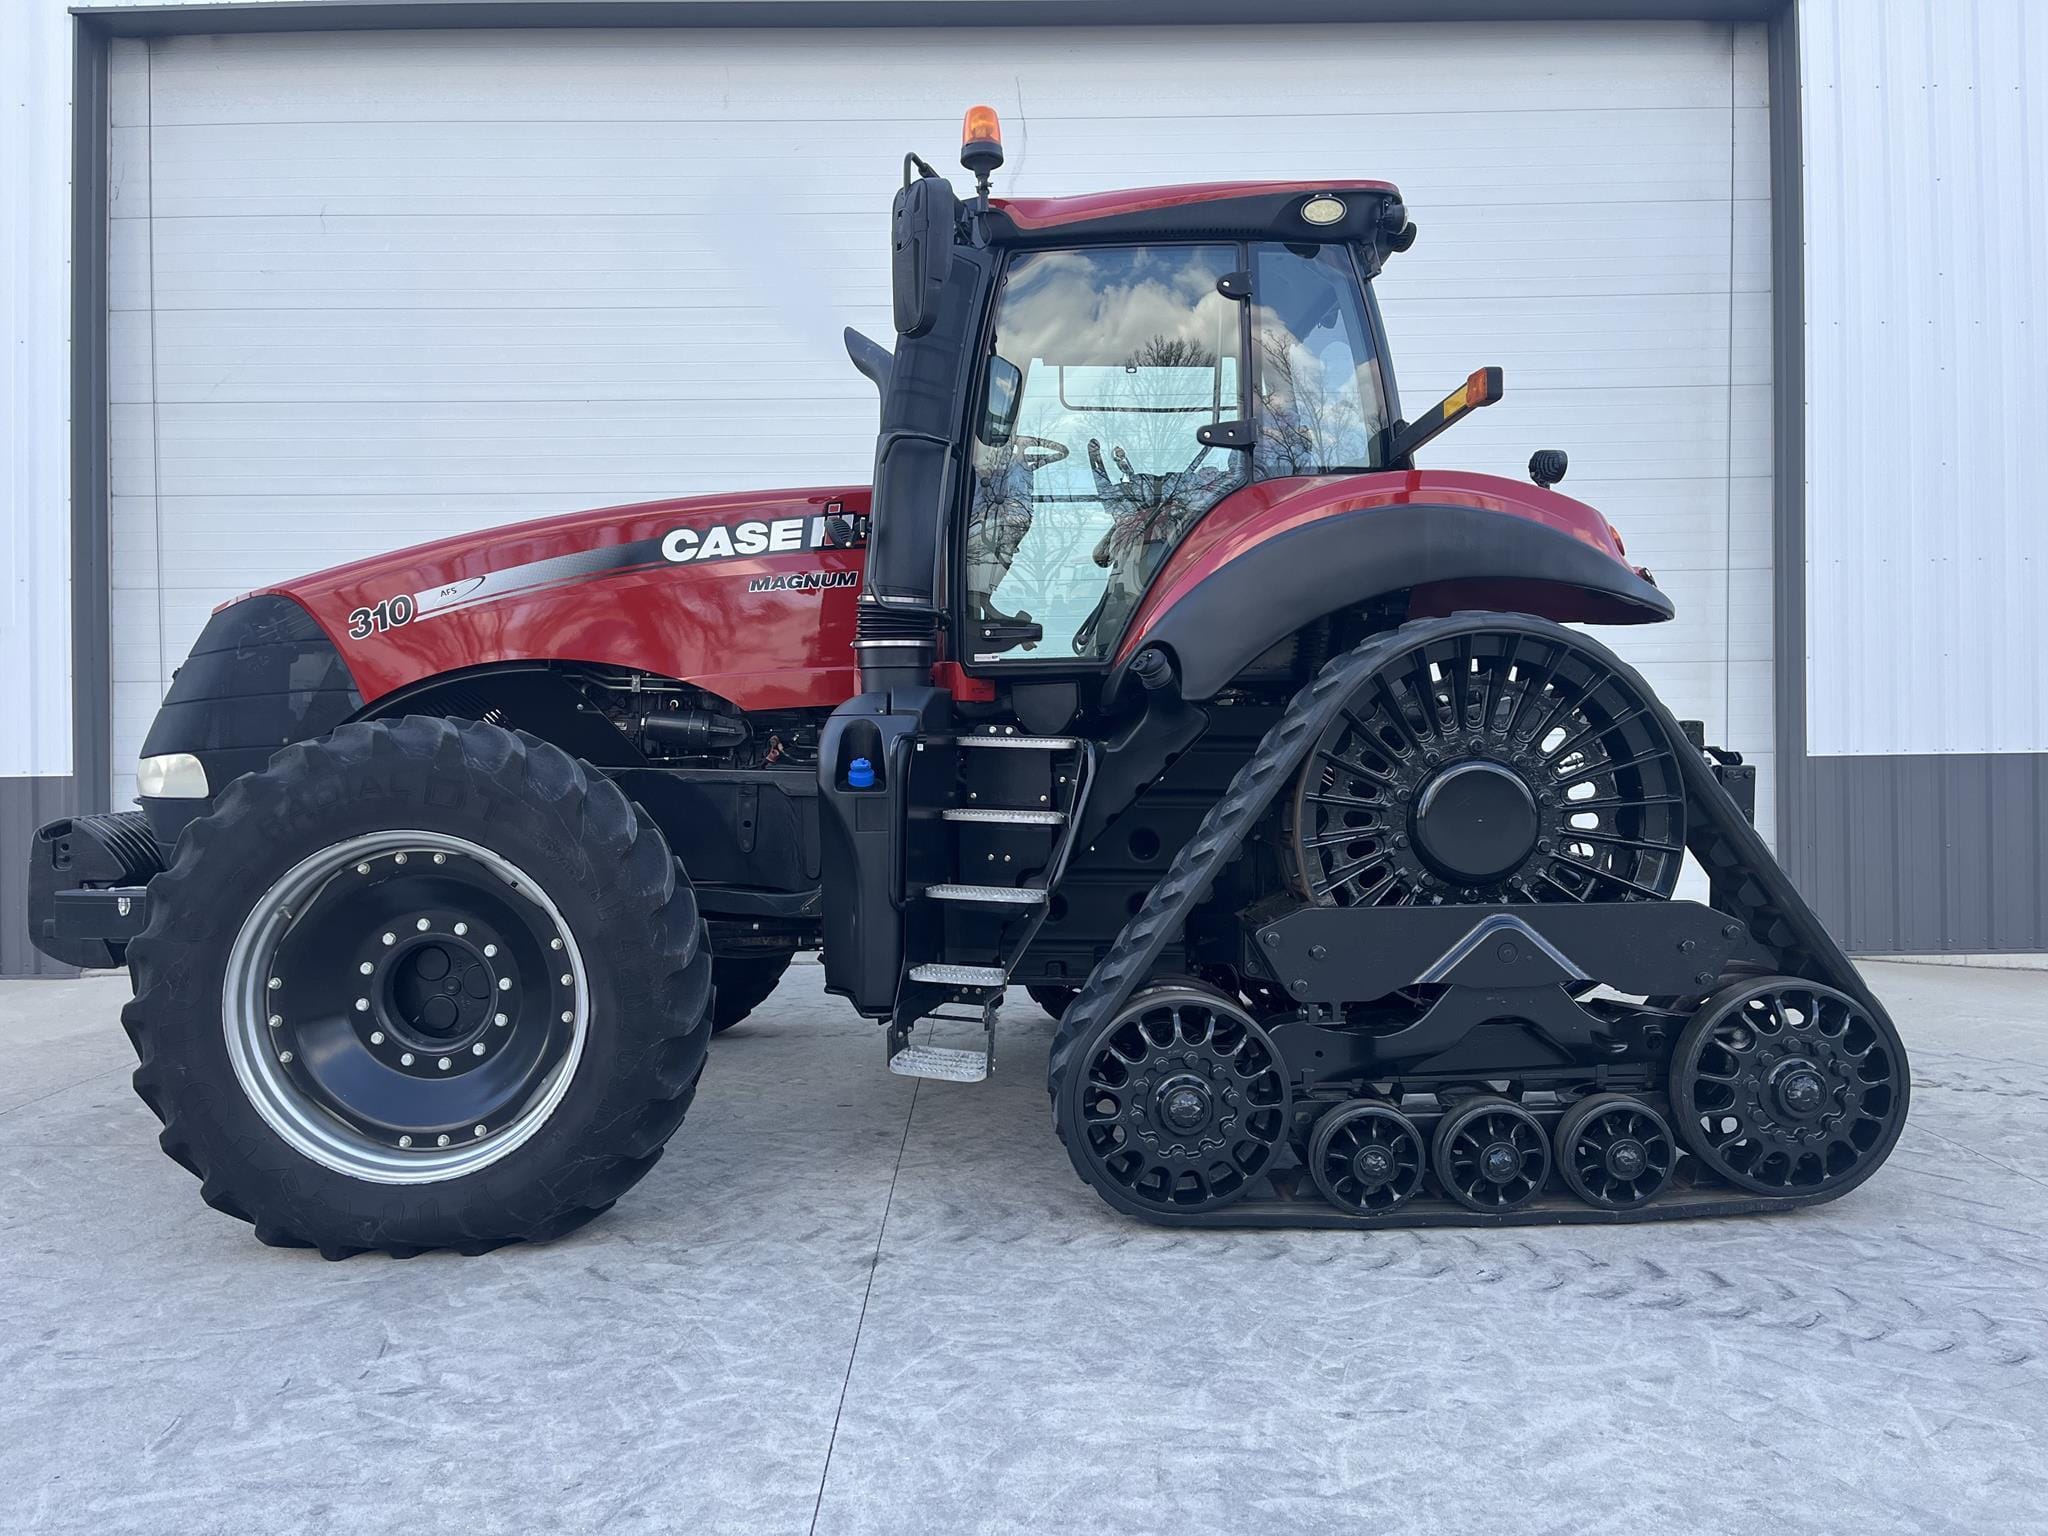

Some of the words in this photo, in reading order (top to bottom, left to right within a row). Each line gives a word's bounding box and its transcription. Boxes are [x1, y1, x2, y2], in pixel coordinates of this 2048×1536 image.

[662, 518, 804, 562] CASE
[440, 587, 458, 598] AFS
[749, 571, 859, 593] MAGNUM
[348, 594, 414, 640] 310
